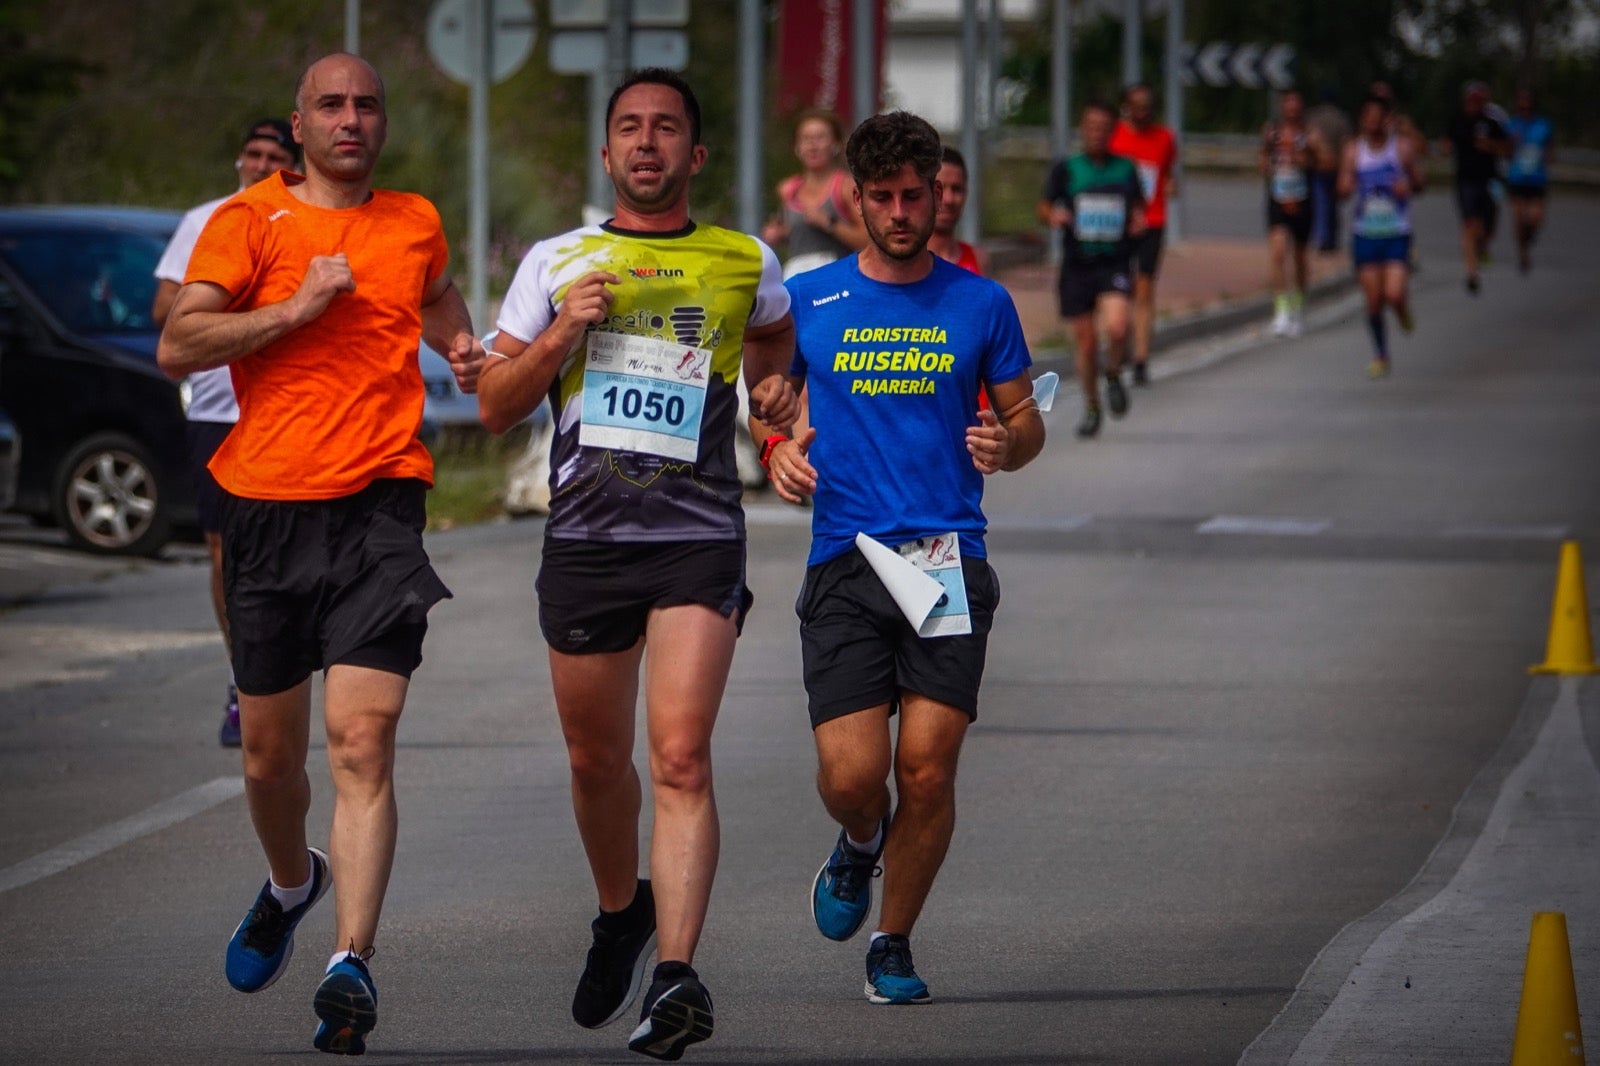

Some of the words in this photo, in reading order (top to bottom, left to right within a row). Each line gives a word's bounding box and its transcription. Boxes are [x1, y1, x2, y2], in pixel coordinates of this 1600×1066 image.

[635, 268, 684, 278] werun
[812, 293, 840, 307] luanvi
[842, 326, 947, 344] FLORISTERÍA
[832, 347, 955, 373] RUISEÑOR
[851, 377, 935, 397] PAJARERÍA
[603, 386, 685, 426] 1050
